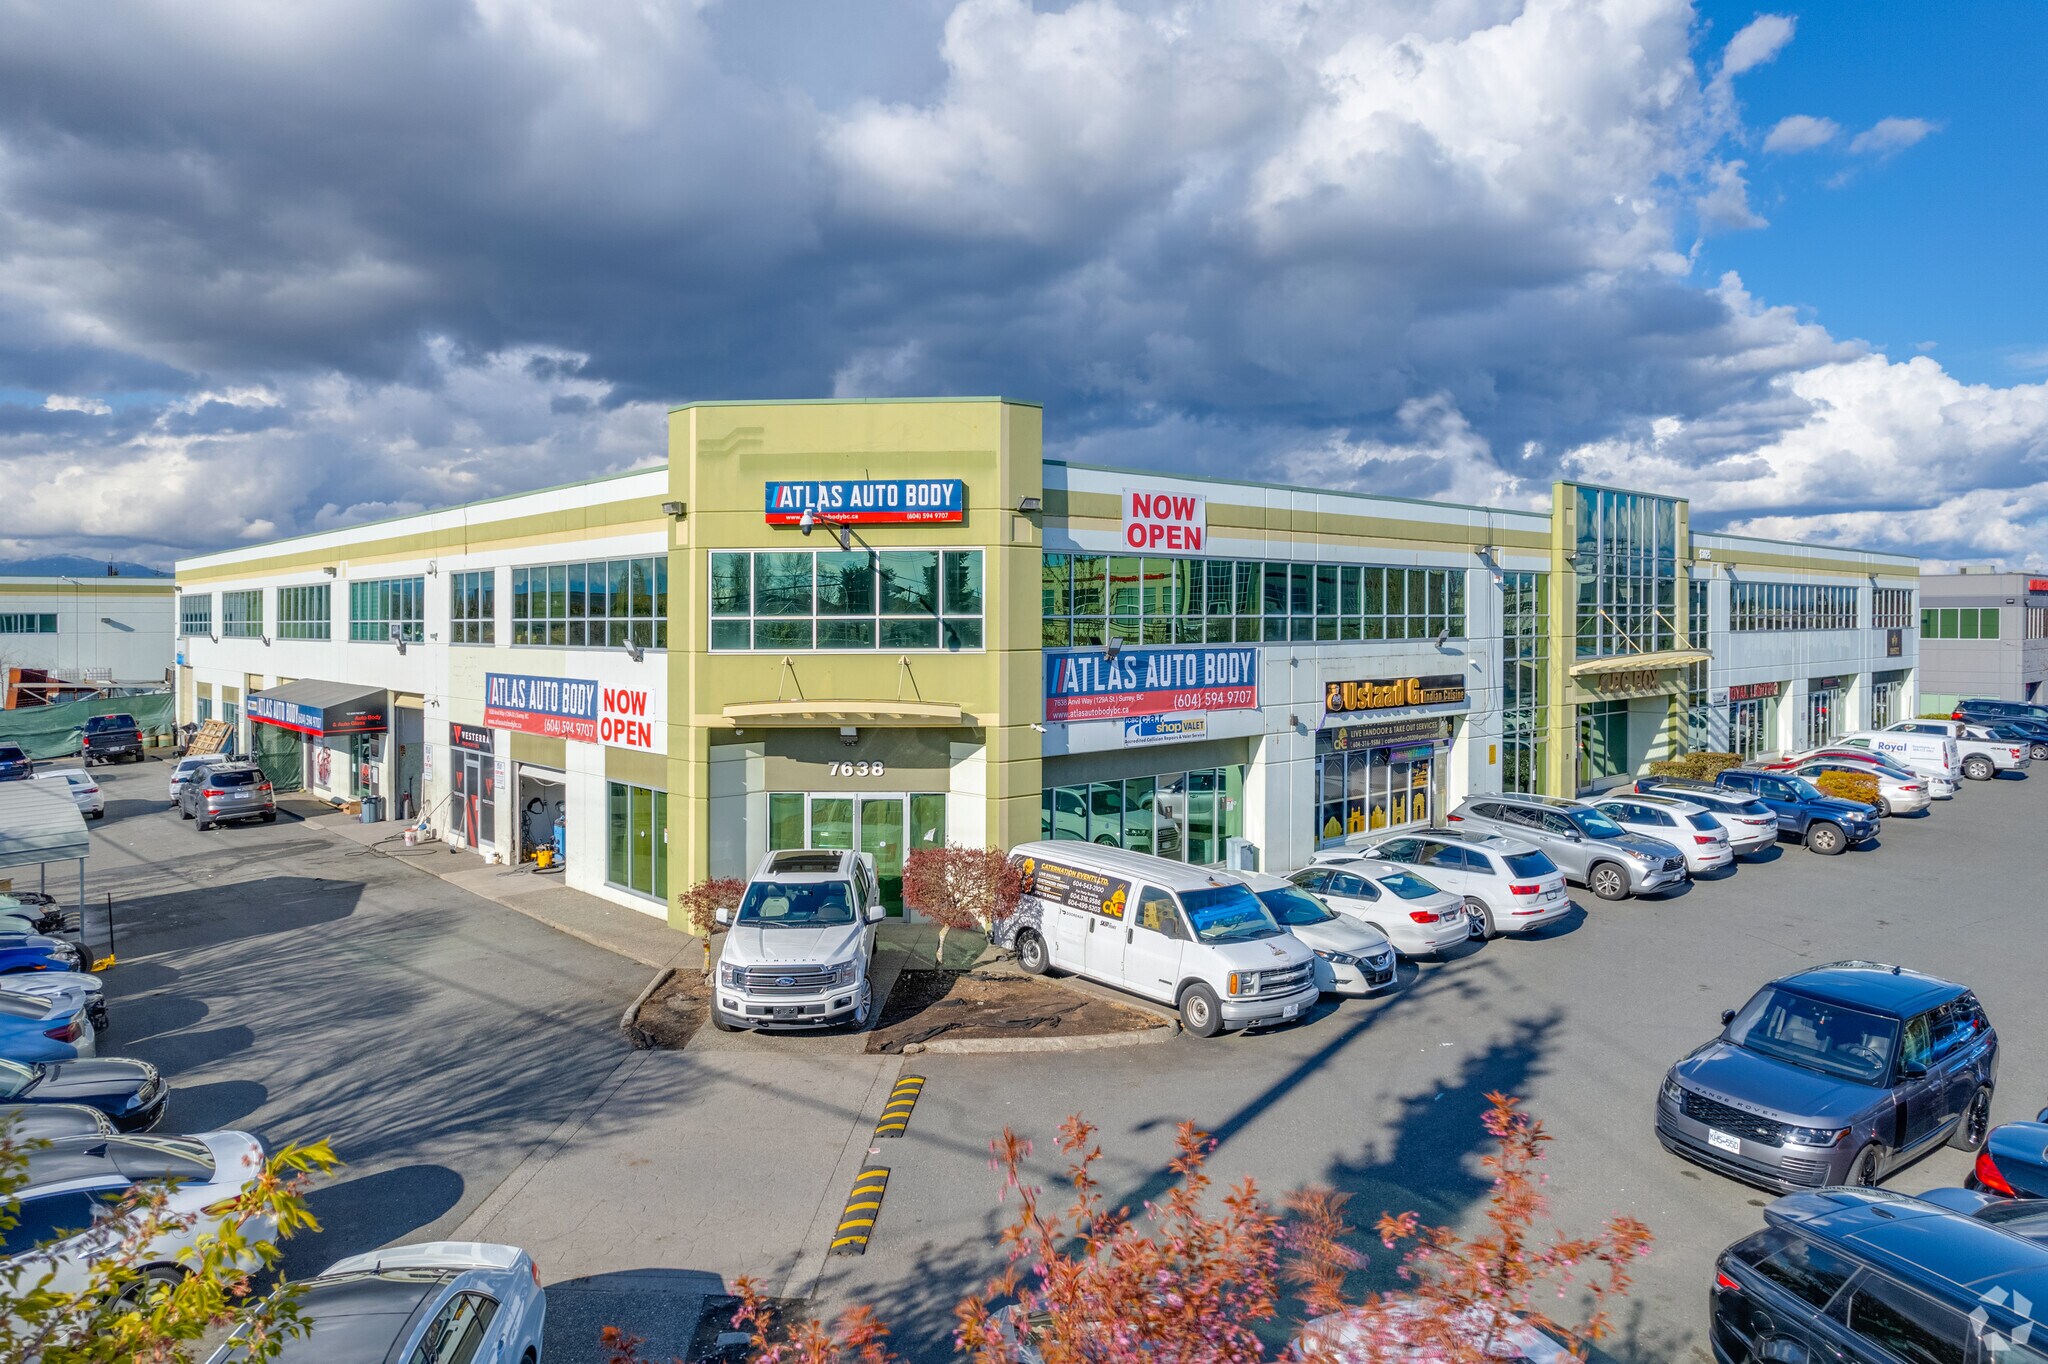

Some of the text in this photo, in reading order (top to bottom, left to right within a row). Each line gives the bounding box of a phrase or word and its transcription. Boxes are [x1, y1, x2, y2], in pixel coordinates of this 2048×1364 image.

[779, 483, 954, 508] ATLAS AUTO BODY
[907, 512, 922, 520] (604)
[922, 512, 934, 520] 594
[934, 512, 949, 520] 9707
[1132, 492, 1196, 521] NOW
[1127, 522, 1201, 550] OPEN
[1062, 652, 1252, 693] ATLAS AUTO BODY
[491, 677, 595, 716] ATLAS AUTO BODY
[603, 688, 647, 717] NOW
[1081, 697, 1093, 706] Way
[1136, 693, 1145, 701] BC
[1173, 690, 1252, 710] (604) 594 9707
[1343, 679, 1404, 711] Ustaad
[1443, 689, 1464, 701] Cuisine
[1053, 706, 1129, 719] www.atlasautobodybc.ca
[544, 718, 594, 738] (604) 594 9707
[601, 717, 652, 748] OPEN
[1156, 721, 1204, 733] shop VALET
[1350, 729, 1362, 738] LIVE
[1363, 726, 1388, 736] TANDOOR
[1393, 725, 1406, 734] TAKE
[1406, 723, 1415, 732] OUT
[1416, 721, 1438, 730] SERVICES
[461, 731, 490, 744] VESTERRA
[1878, 741, 1907, 753] Royal
[827, 760, 885, 777] 7638
[1041, 863, 1077, 878] CATERNATION
[1077, 872, 1098, 882] EVENTS
[1695, 1086, 1779, 1117] RANGE ROVER
